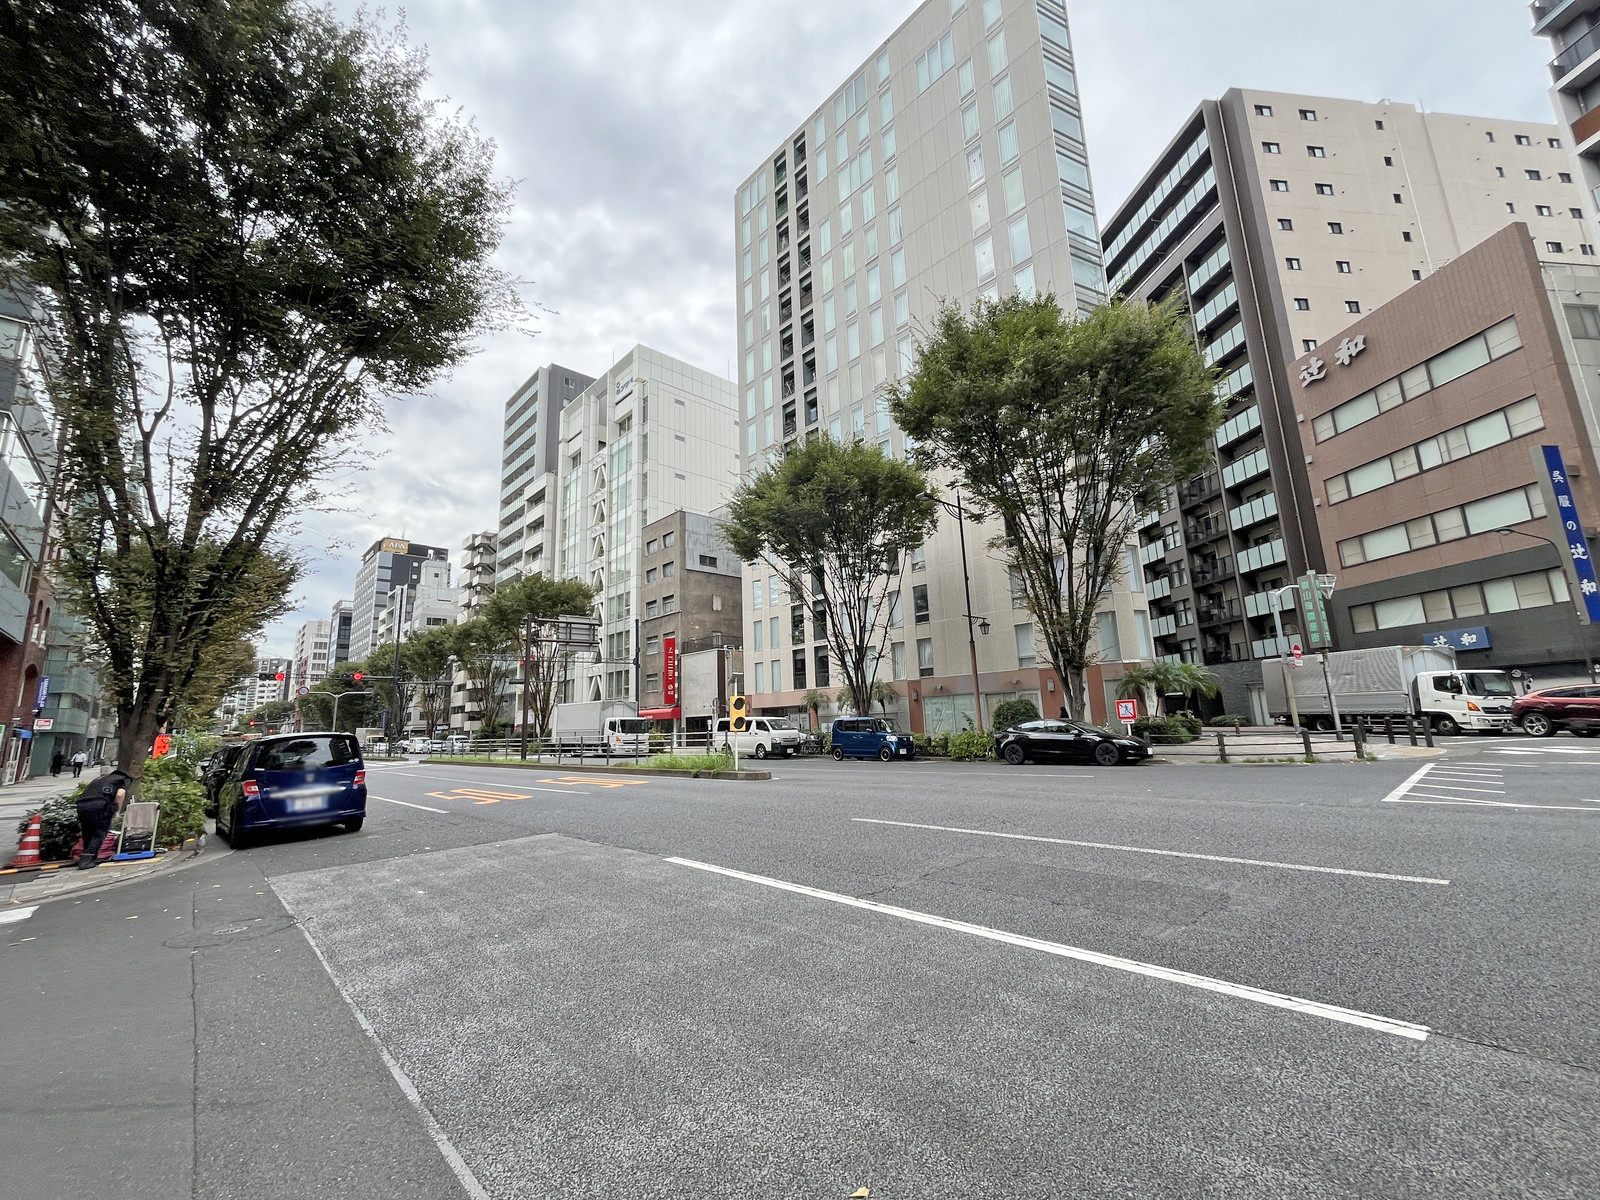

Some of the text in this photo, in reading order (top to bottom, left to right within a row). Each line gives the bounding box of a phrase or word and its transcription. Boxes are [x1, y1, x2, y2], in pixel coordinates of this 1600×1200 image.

[1299, 335, 1366, 388] 辻和
[1552, 470, 1598, 596] 呉服の辻和
[388, 542, 405, 550] APA
[1432, 632, 1477, 648] 辻和
[424, 788, 533, 805] 50
